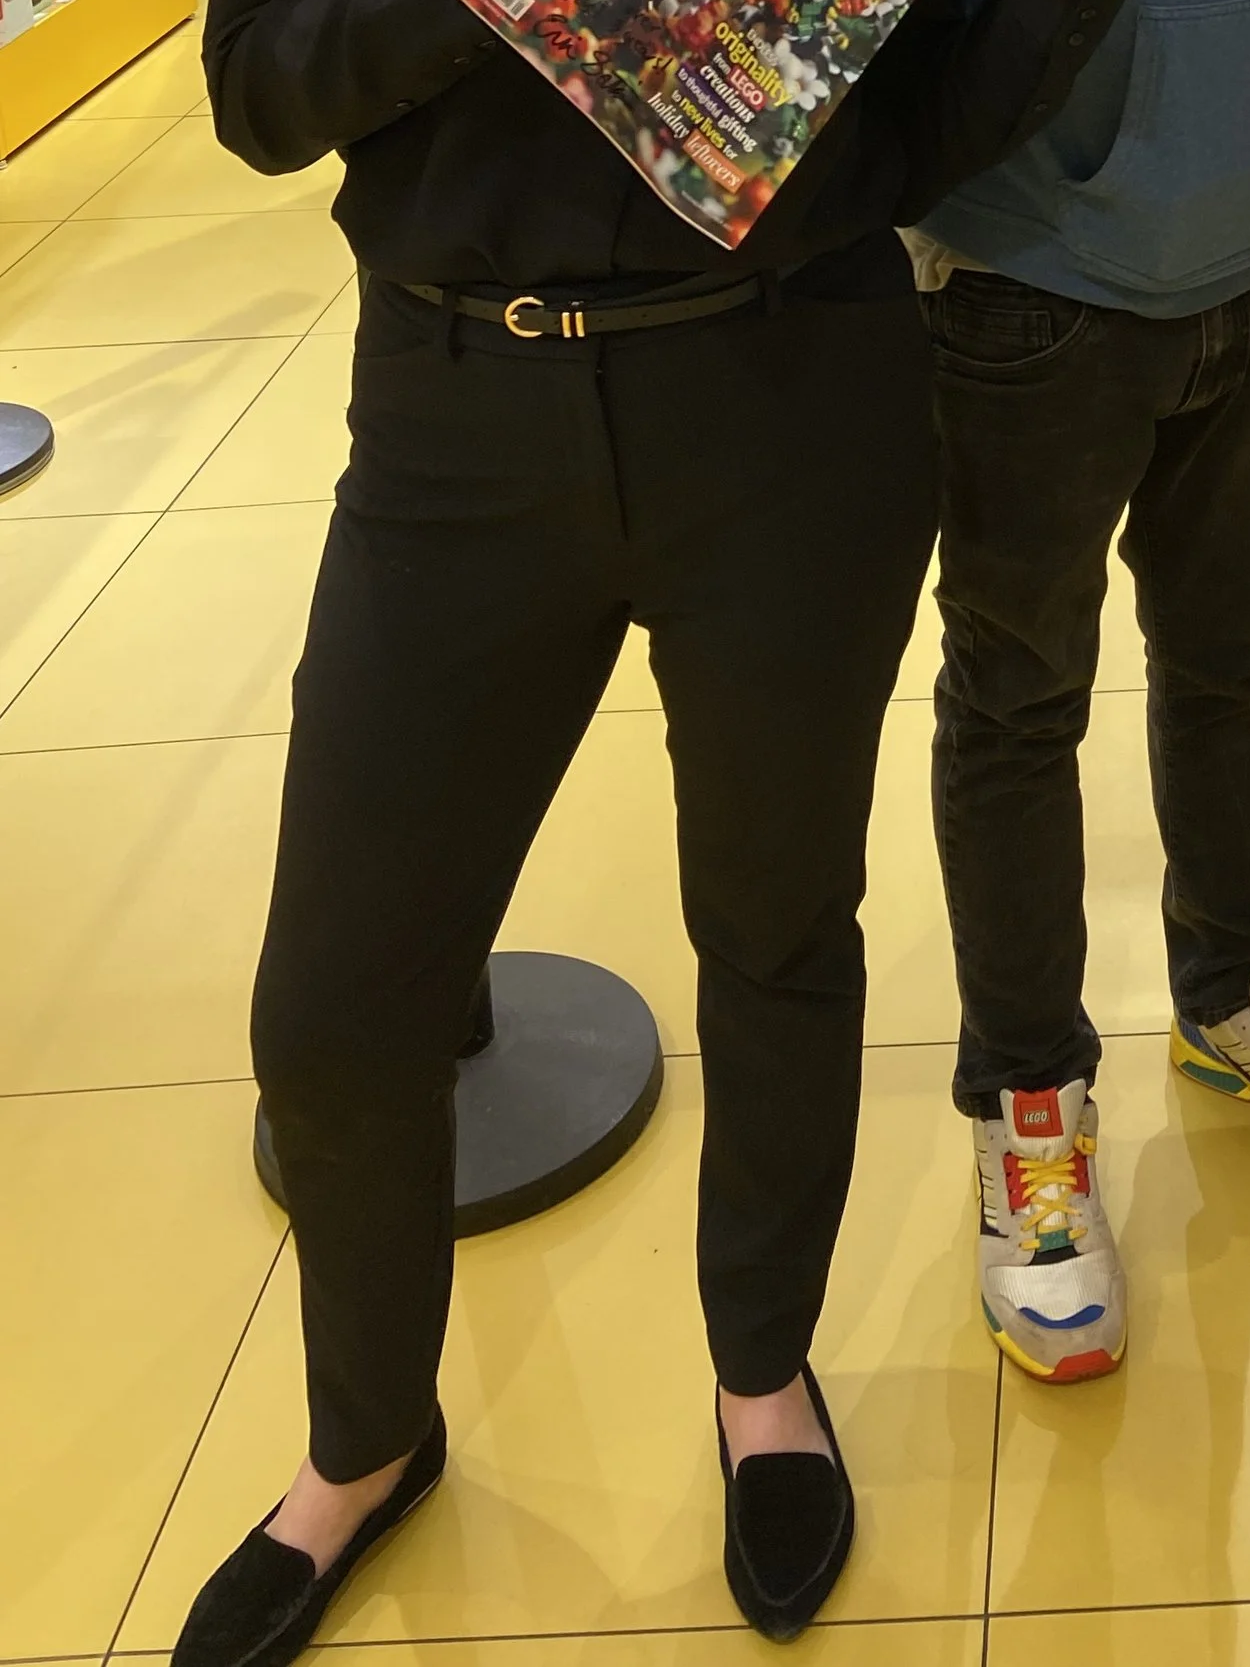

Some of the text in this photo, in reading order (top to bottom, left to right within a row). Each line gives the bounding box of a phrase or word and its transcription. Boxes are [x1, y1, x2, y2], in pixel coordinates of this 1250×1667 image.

[699, 64, 756, 124] creations
[713, 51, 764, 106] from LEGO
[715, 21, 793, 107] originality
[646, 91, 742, 189] holiday leftovers
[671, 89, 739, 160] to new lives for
[677, 68, 758, 153] to thoughtful gifting
[1023, 1110, 1049, 1124] LEGO
